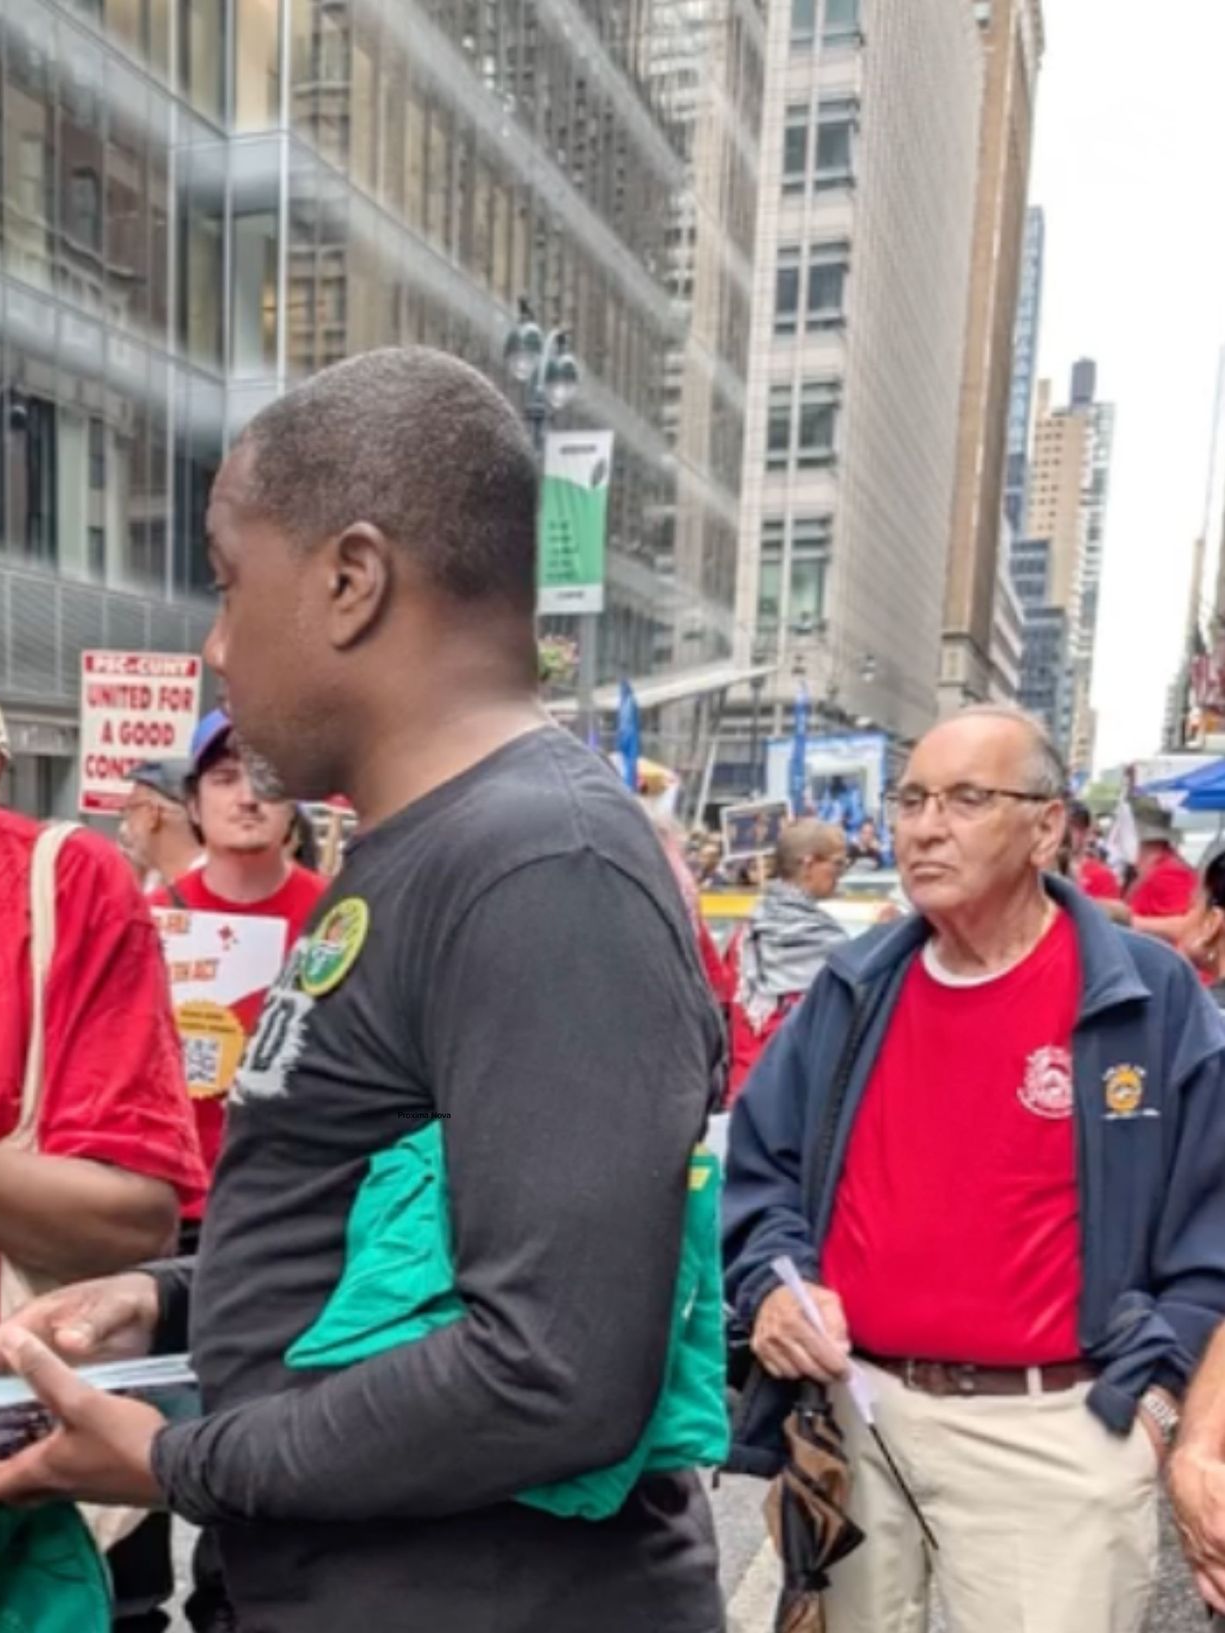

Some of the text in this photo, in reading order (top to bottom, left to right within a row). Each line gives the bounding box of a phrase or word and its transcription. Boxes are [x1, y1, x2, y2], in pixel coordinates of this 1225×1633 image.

[87, 684, 194, 711] UNITED FOR
[101, 720, 175, 747] A GOOD
